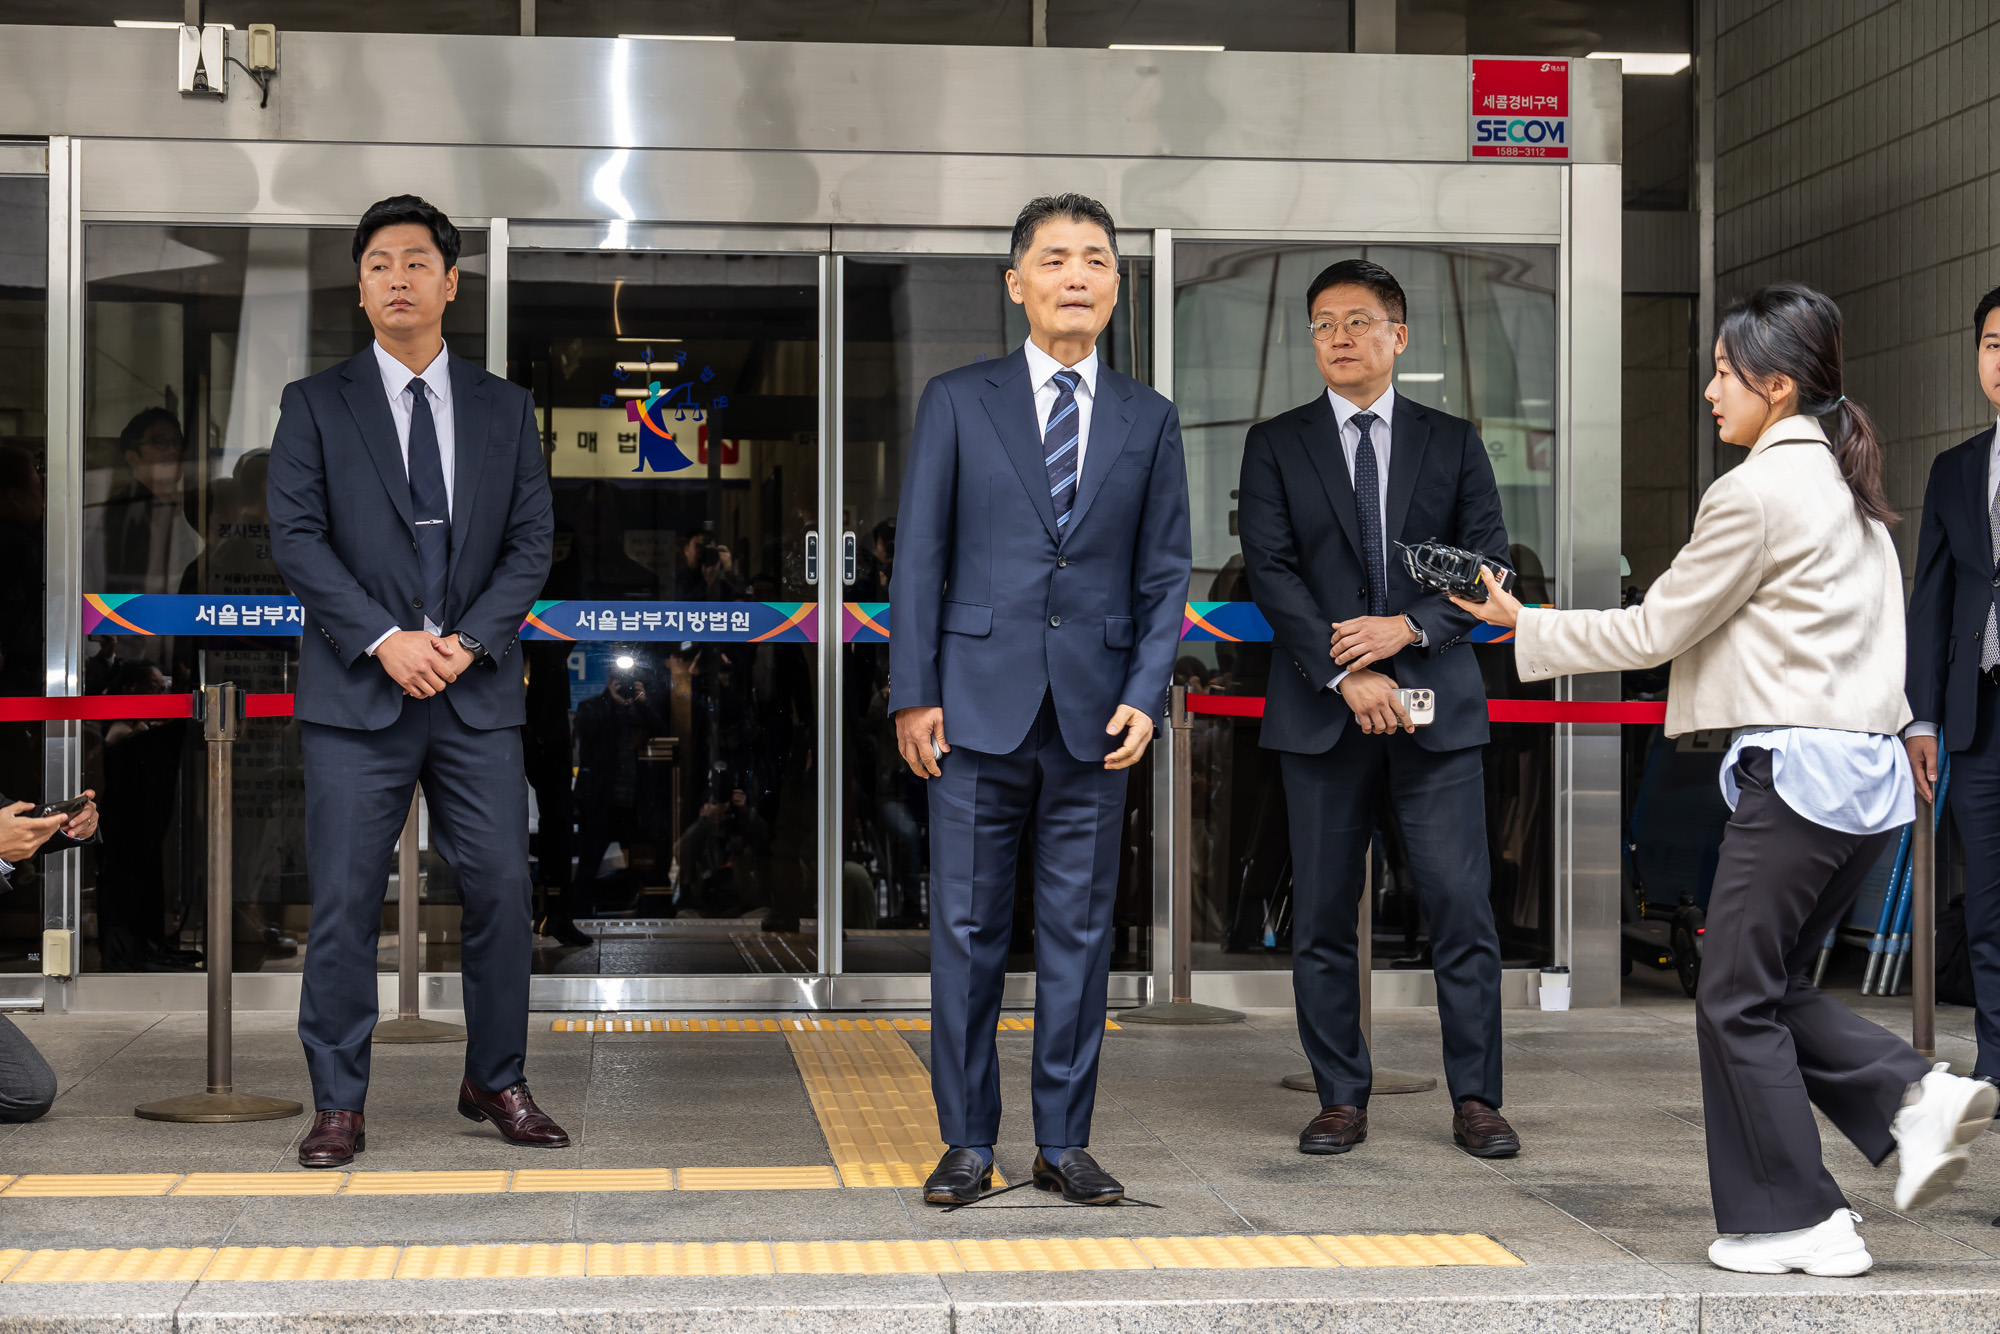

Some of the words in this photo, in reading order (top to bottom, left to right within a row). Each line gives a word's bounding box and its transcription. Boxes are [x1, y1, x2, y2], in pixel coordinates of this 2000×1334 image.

[1482, 94, 1558, 110] 세콤경비구역
[1476, 119, 1565, 144] SECOM
[1496, 147, 1546, 157] 1588-3112
[195, 604, 305, 627] 서울남부지
[575, 609, 751, 632] 서울남부지방법원
